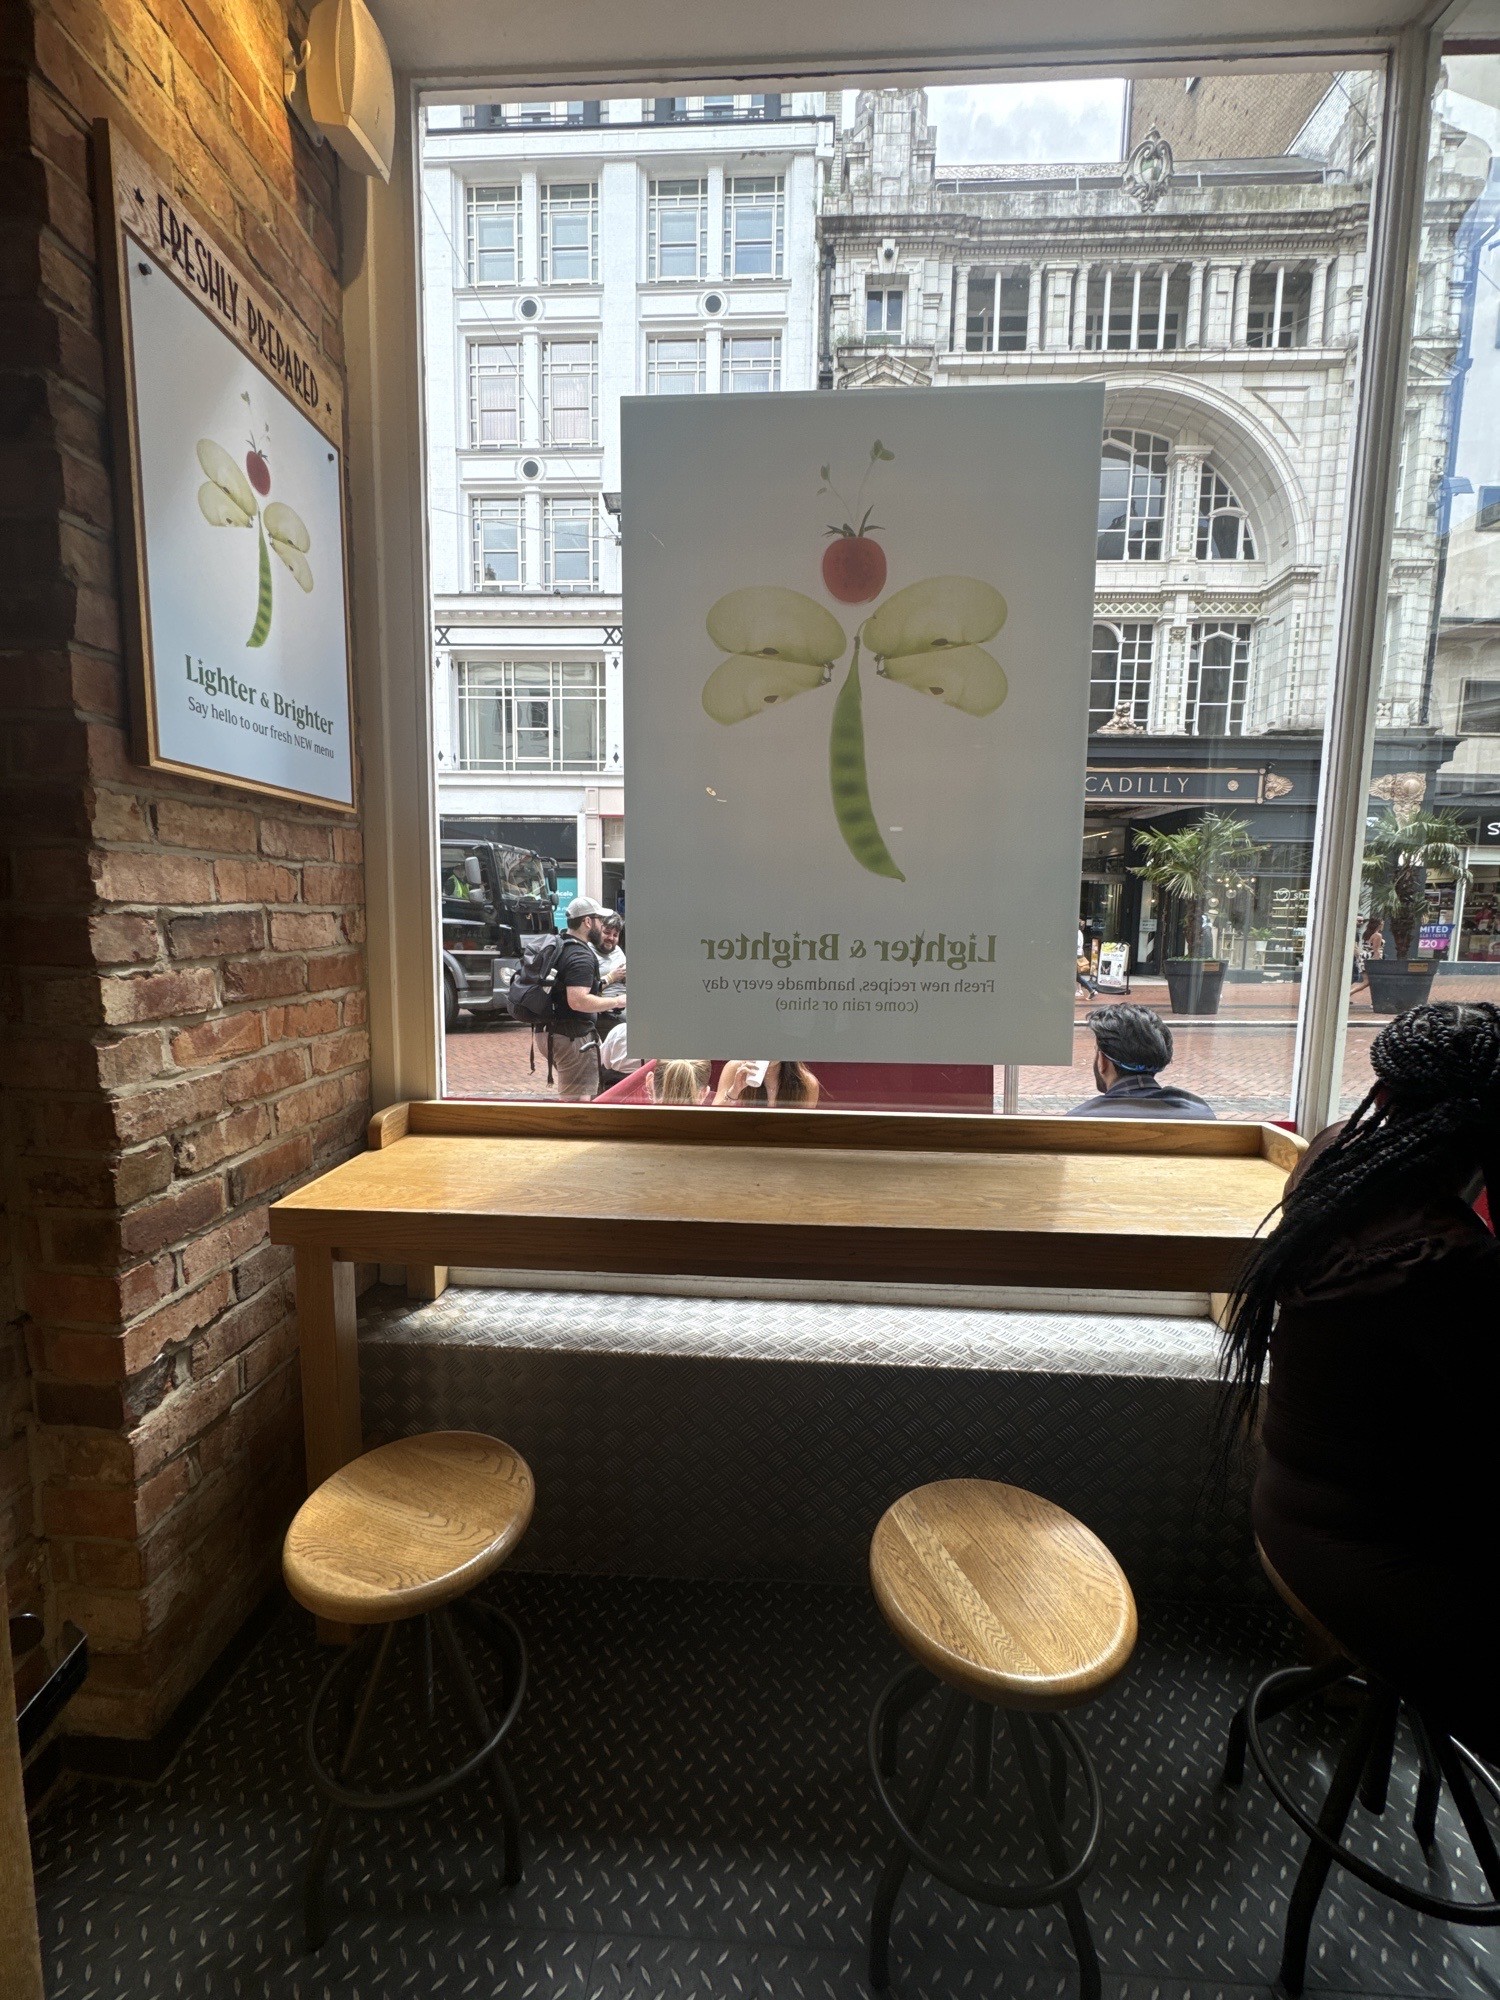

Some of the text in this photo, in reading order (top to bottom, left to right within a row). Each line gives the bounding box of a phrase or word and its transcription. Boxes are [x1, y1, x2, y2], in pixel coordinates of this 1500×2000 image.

[157, 192, 319, 408] FRESHLY PREPARED
[185, 653, 334, 736] Lighter & Brighter
[188, 696, 335, 759] Say hello to our fresh NEW menu
[1085, 776, 1190, 794] CADILLY
